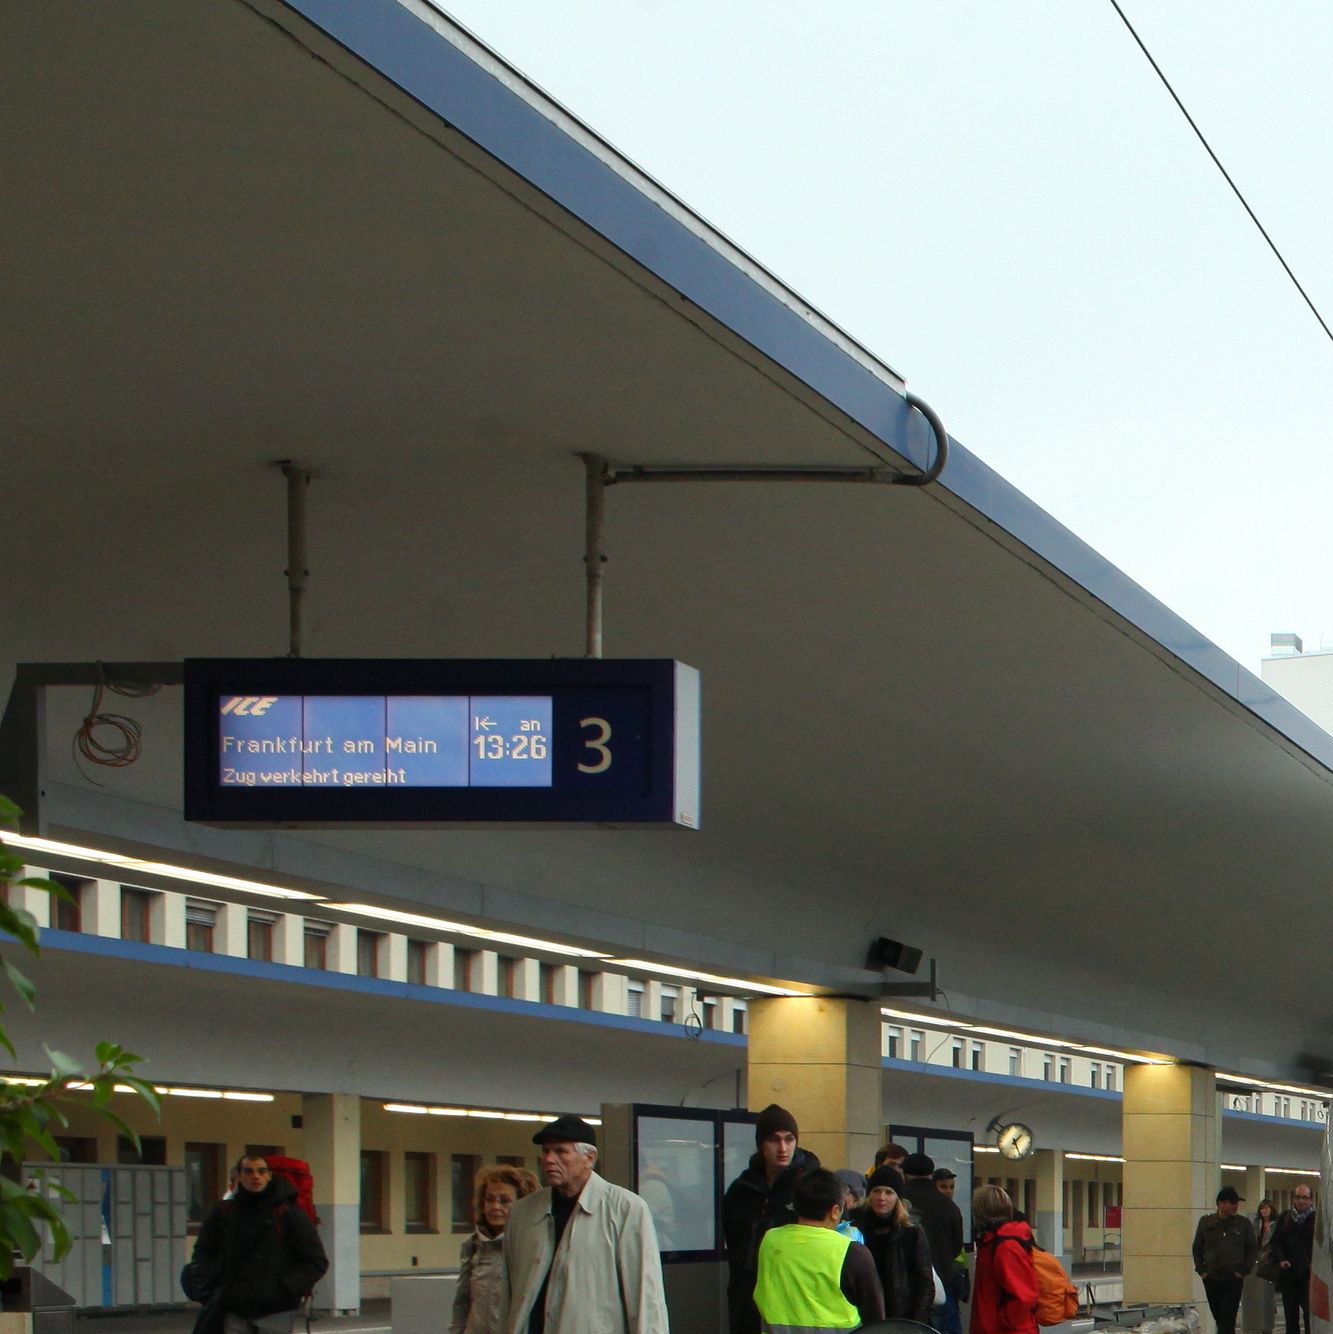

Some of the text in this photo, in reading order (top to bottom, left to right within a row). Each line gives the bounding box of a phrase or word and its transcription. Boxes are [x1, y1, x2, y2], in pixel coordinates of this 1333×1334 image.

[220, 696, 279, 716] ICE
[520, 719, 541, 731] an
[222, 736, 437, 753] Frankfurt am Main
[473, 735, 547, 759] 13:26
[577, 717, 613, 774] 3
[223, 767, 406, 786] Zug verkehrt gereiht
